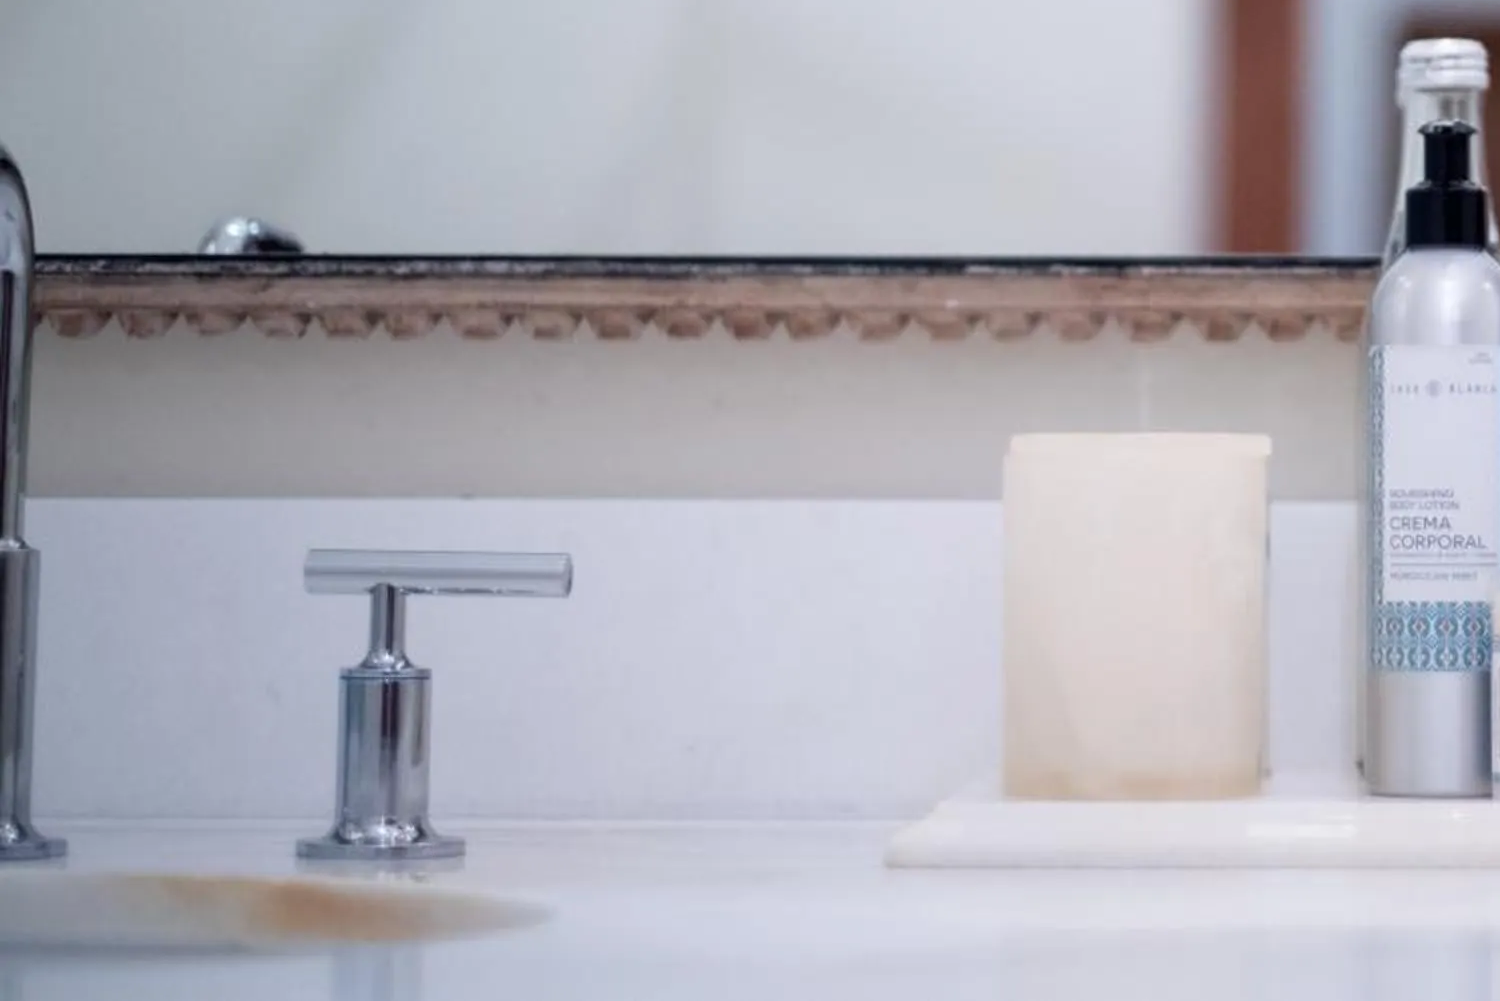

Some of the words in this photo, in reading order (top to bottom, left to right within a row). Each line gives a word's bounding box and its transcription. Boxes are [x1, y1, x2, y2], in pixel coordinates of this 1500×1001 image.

[1418, 500, 1460, 510] LOTION
[1389, 516, 1452, 531] CREMA
[1389, 534, 1488, 550] CORPORAL
